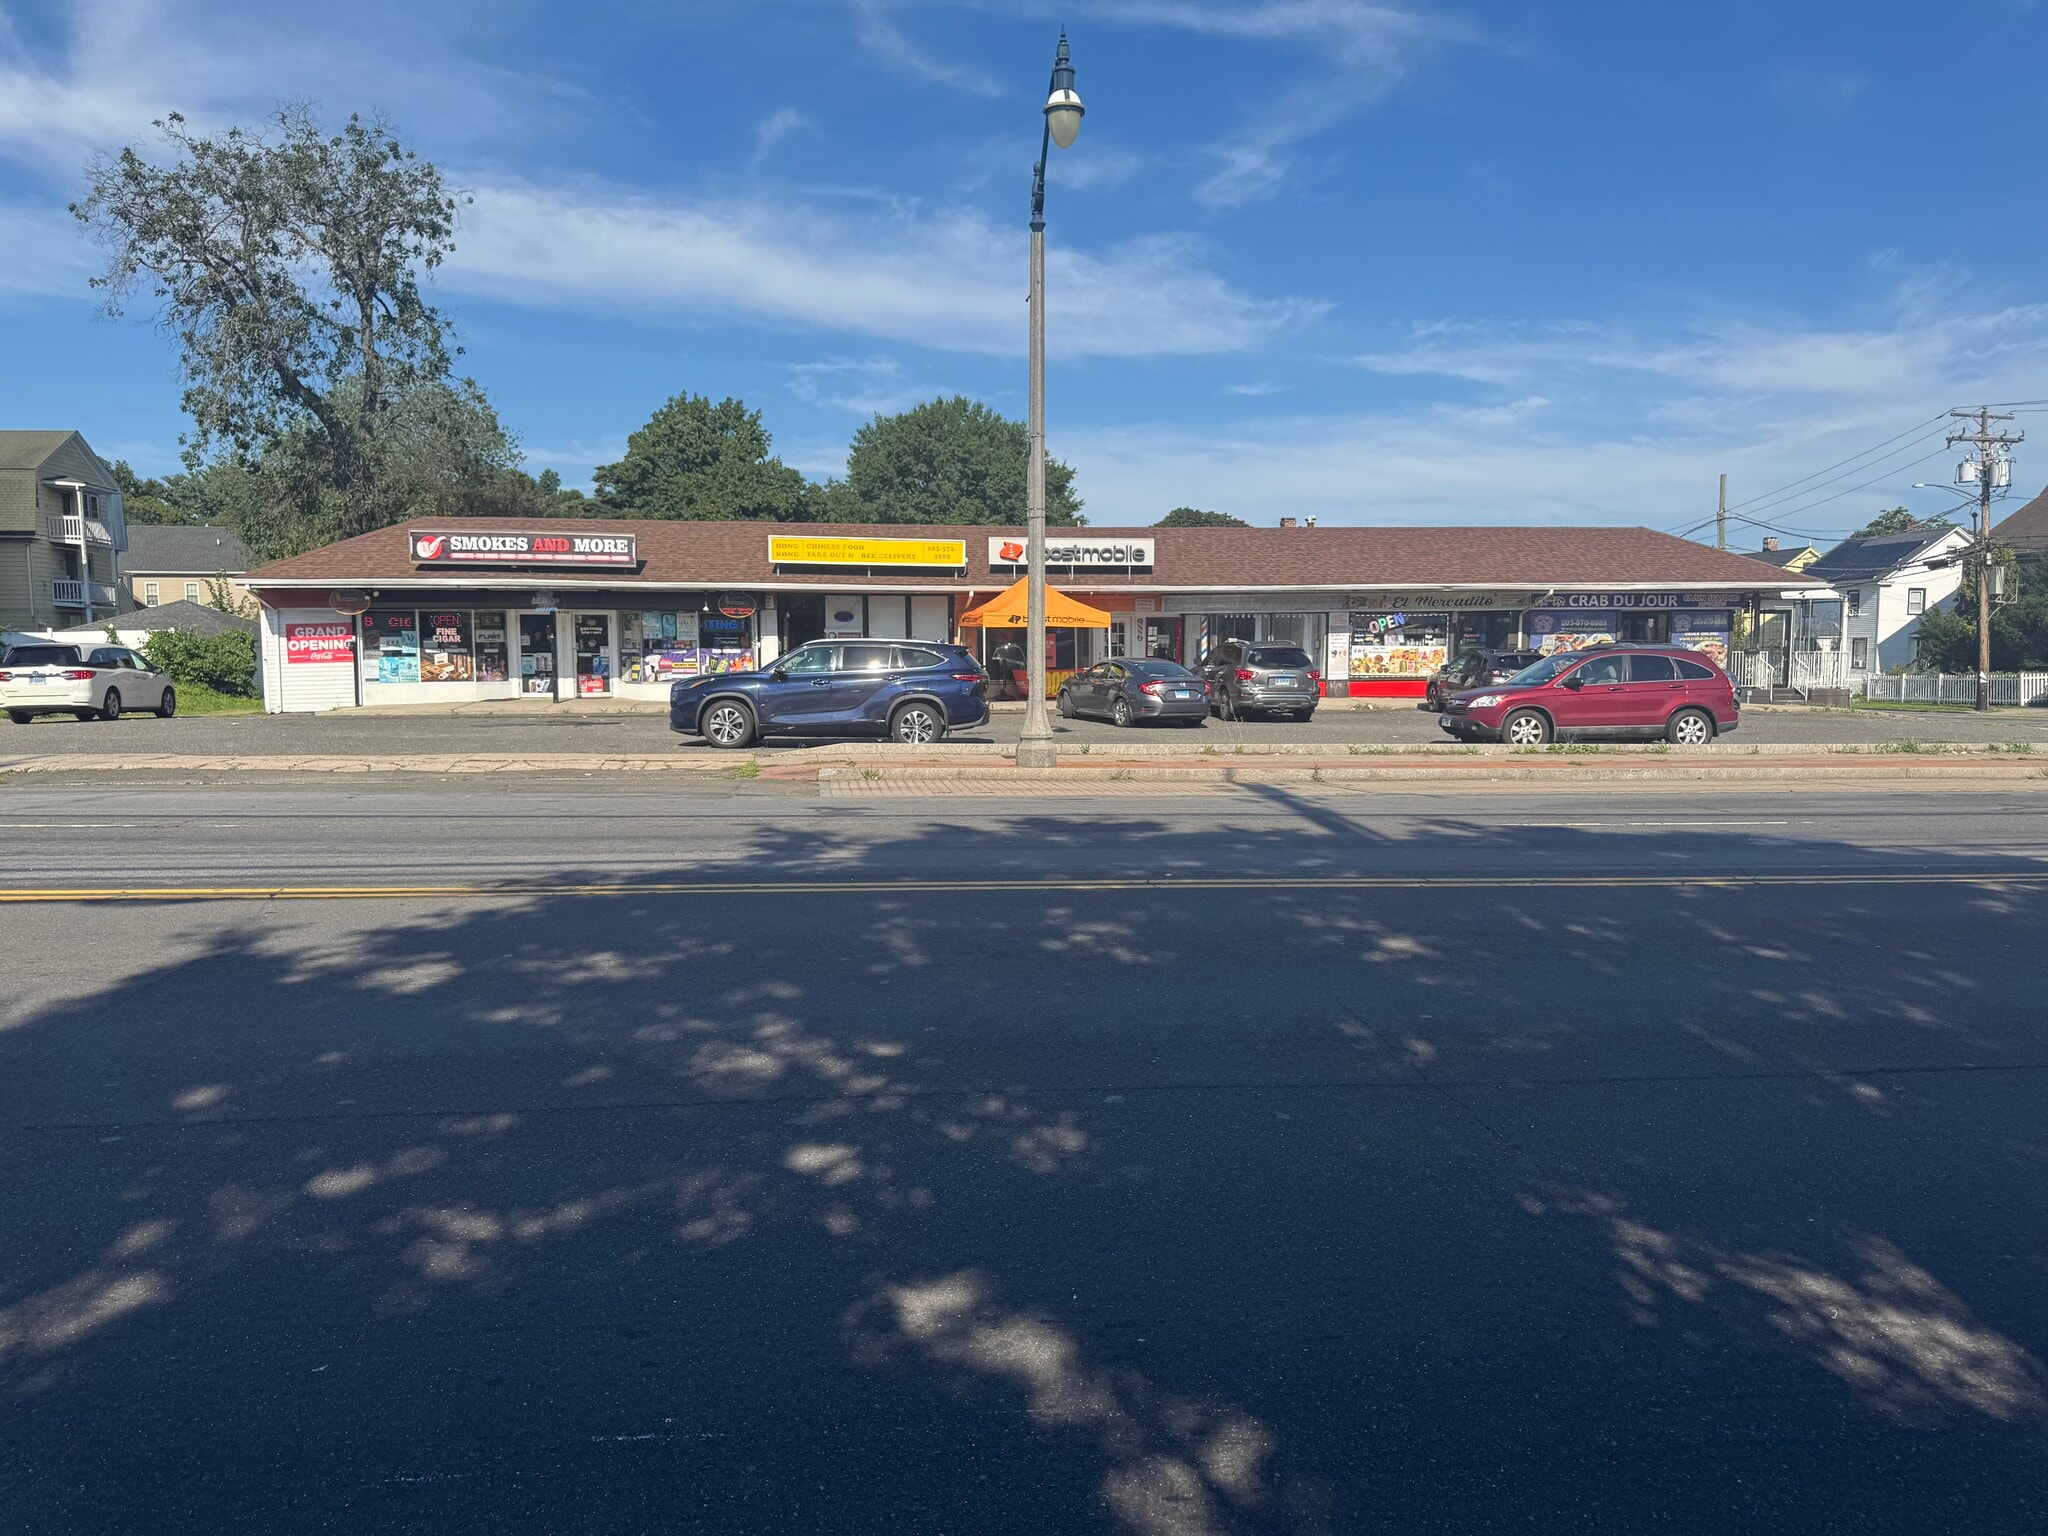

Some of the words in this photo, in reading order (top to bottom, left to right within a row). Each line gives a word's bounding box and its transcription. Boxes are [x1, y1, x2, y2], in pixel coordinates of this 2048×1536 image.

[450, 536, 529, 552] SMOKES
[532, 538, 570, 552] AND
[573, 538, 629, 553] MORE
[879, 552, 917, 560] ELIVERY
[1026, 545, 1145, 563] ostmobile
[1392, 596, 1409, 608] El
[1568, 594, 1609, 607] CRAB
[1613, 595, 1634, 607] DU
[1639, 595, 1678, 608] JOUR
[432, 615, 461, 626] OPEN
[1368, 613, 1406, 634] OPEN
[294, 626, 347, 637] GRAND
[435, 627, 458, 636] FINE
[432, 634, 462, 643] CIGAR
